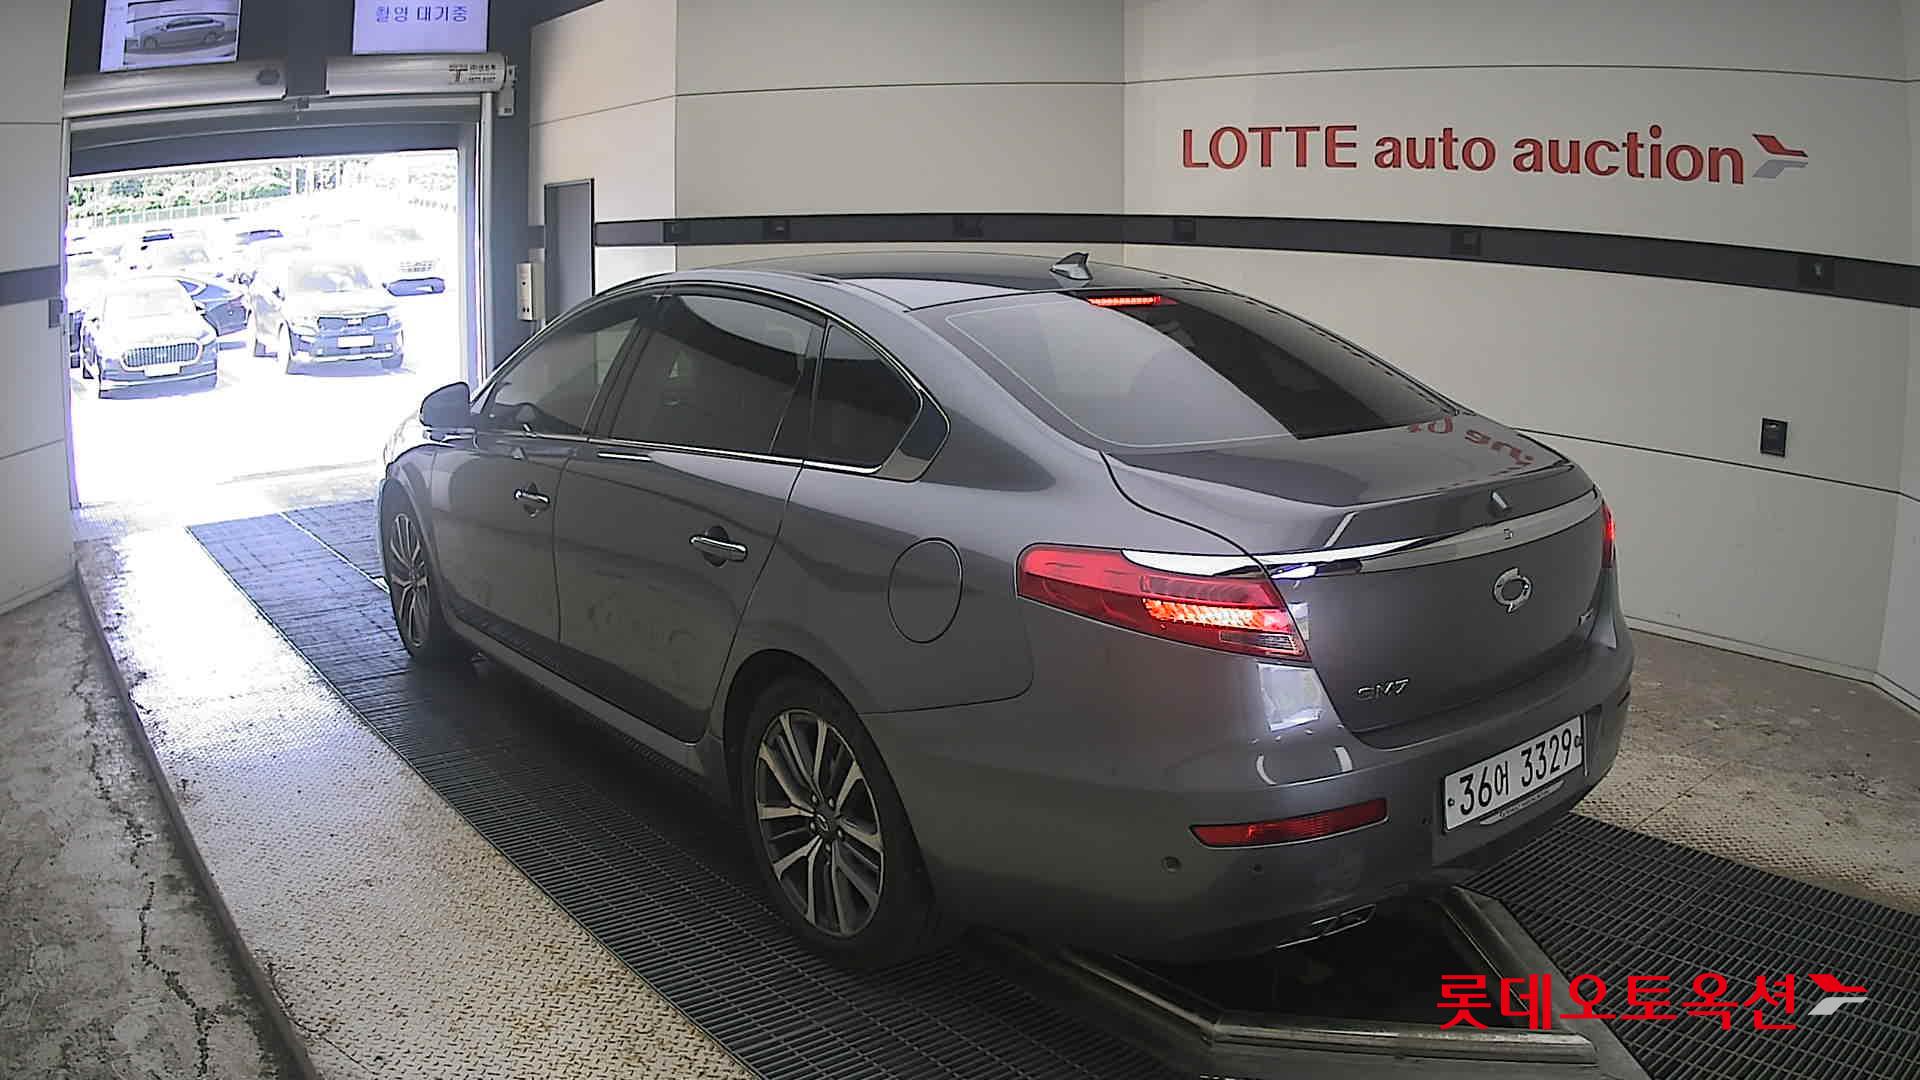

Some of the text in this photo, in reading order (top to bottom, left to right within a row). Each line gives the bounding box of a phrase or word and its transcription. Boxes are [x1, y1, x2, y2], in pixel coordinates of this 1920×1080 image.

[417, 5, 469, 23] 대기중
[1182, 124, 1745, 185] LOTTE auto auction
[1459, 759, 1510, 816] 36어
[1520, 727, 1573, 787] 3329
